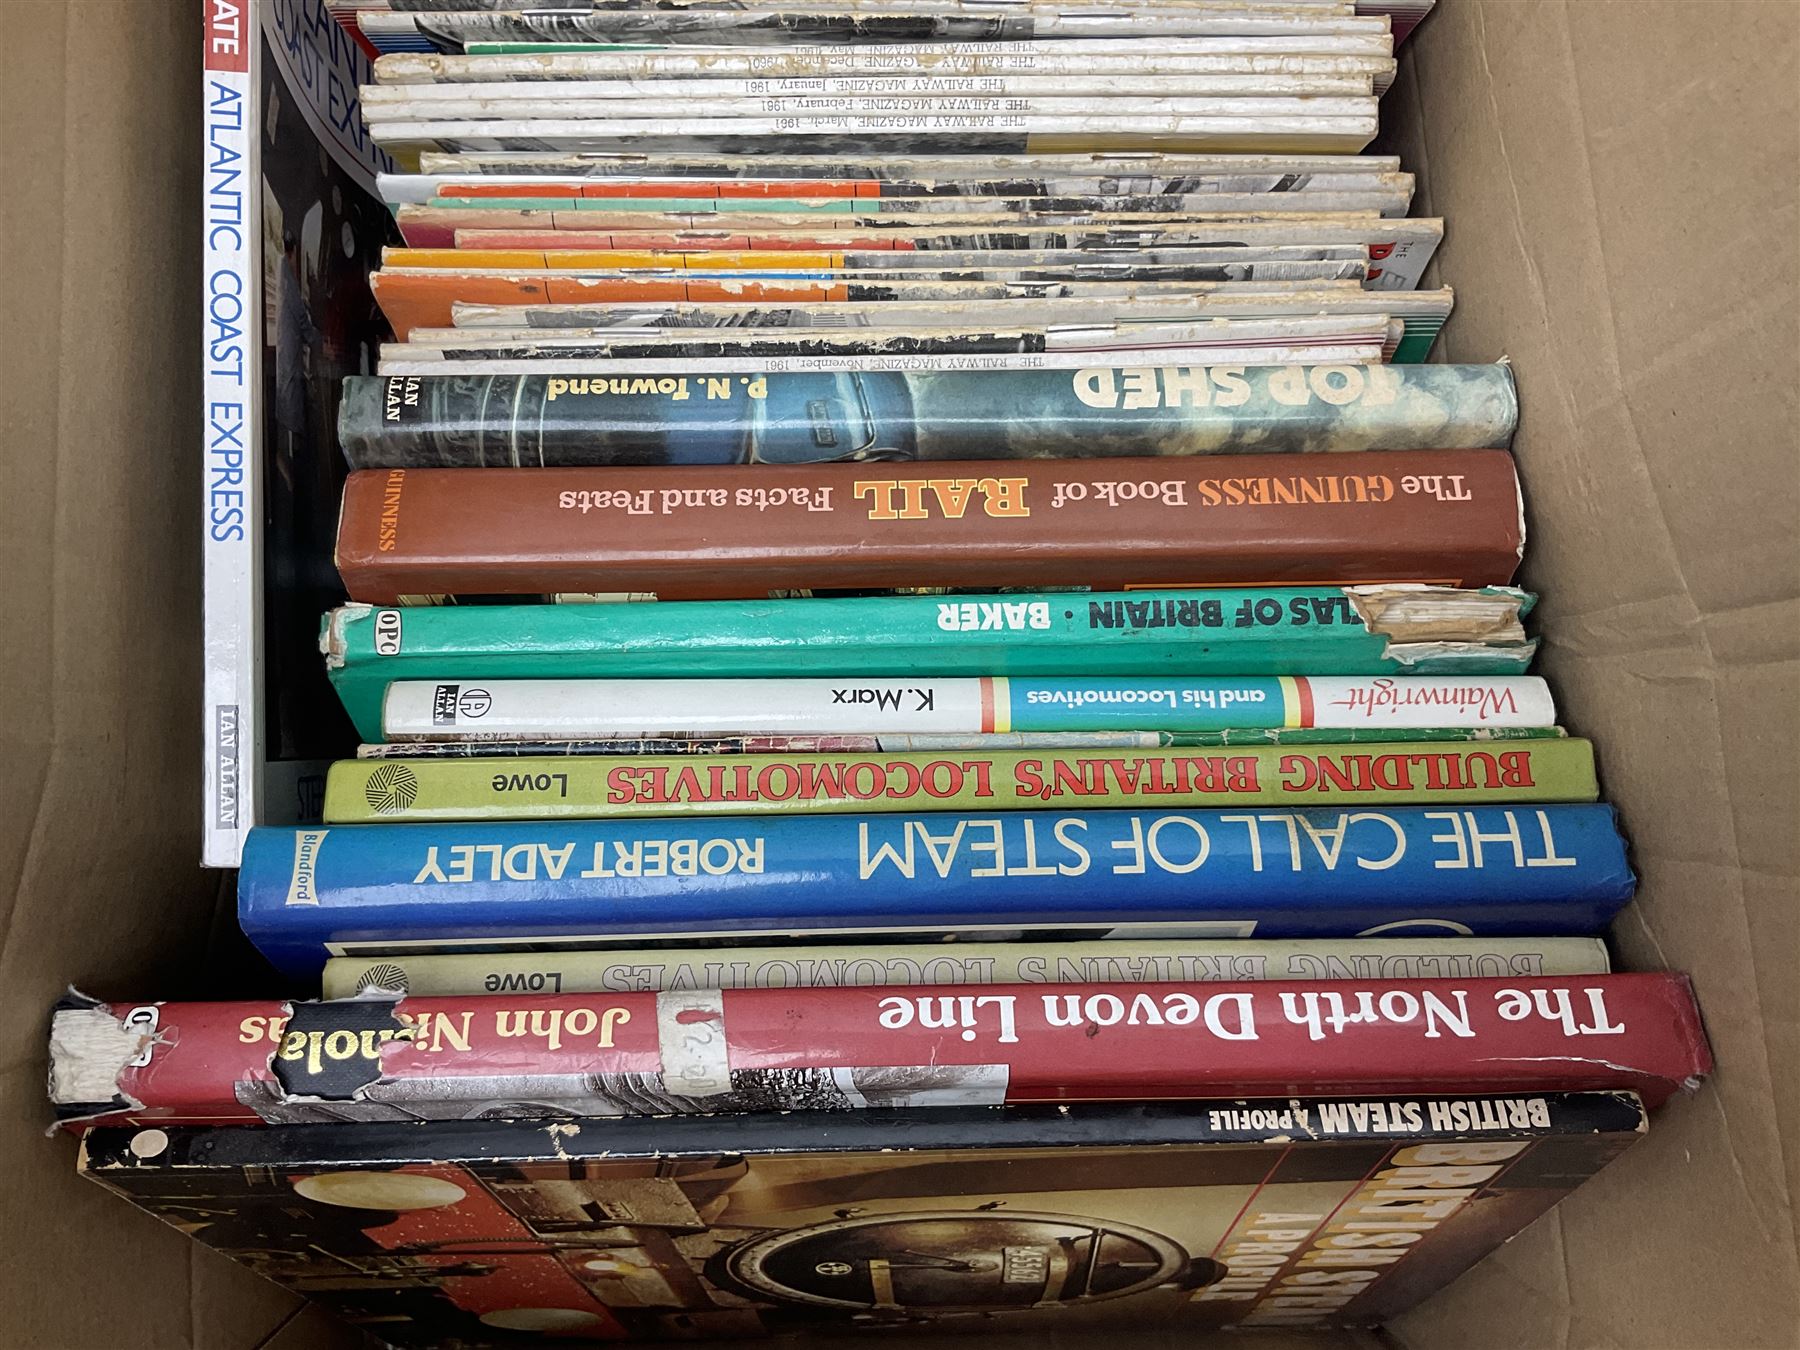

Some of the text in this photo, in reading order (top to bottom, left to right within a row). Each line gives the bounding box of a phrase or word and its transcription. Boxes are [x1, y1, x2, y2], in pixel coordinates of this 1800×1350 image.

[1011, 56, 1036, 67] THE
[744, 78, 1006, 92] THE RAILWAY MAGAZINE, January, 1961
[761, 99, 1031, 112] THE RAILWAY MAGAZINE, February, 1961
[774, 117, 801, 129] 1961
[933, 115, 996, 127] RAILWAY
[999, 115, 1026, 127] THE
[208, 81, 244, 542] ATLANTIC COAST EXPRESS
[764, 356, 1045, 371] THE RAILWAY MAGAZINE, November, 1961
[386, 376, 404, 422] LLAN
[404, 377, 421, 407] IAN
[547, 377, 769, 401] P. N. Townend
[1072, 365, 1398, 409] TOP SHED
[378, 470, 405, 552] GUINNESS
[559, 474, 1472, 520] The GUINNESS Book of RAIL Facts and Feats
[937, 602, 1051, 632] BAKER
[1088, 599, 1224, 629] BRITAIN
[1235, 599, 1286, 627] OF
[379, 612, 399, 654] OPC
[434, 686, 447, 723] ALLAN
[446, 693, 456, 714] IAN
[832, 678, 1520, 717] Wainwright and his Locomotives K. Marx
[220, 710, 235, 824] IAN ALLAN
[492, 751, 1536, 804] BUILDING BRITAIN'S LOCOMOTIVES Lowe
[413, 811, 1577, 884] THE CALL OF STEAM ROBERT ADLEY
[297, 833, 319, 900] Blandford
[485, 972, 563, 993] Lowe
[602, 957, 995, 991] LOCOMOTIVES
[495, 1006, 632, 1049] John
[878, 996, 1019, 1044] Line
[1040, 992, 1260, 1042] Devon
[1284, 988, 1476, 1041] North
[1494, 986, 1626, 1037] The
[1208, 1108, 1292, 1131] PROFILE
[1317, 1101, 1424, 1133] STEAM
[1427, 1098, 1552, 1130] BRITISH
[1298, 1141, 1533, 1267] BRITISH
[1193, 1211, 1324, 1303] A PROFILE
